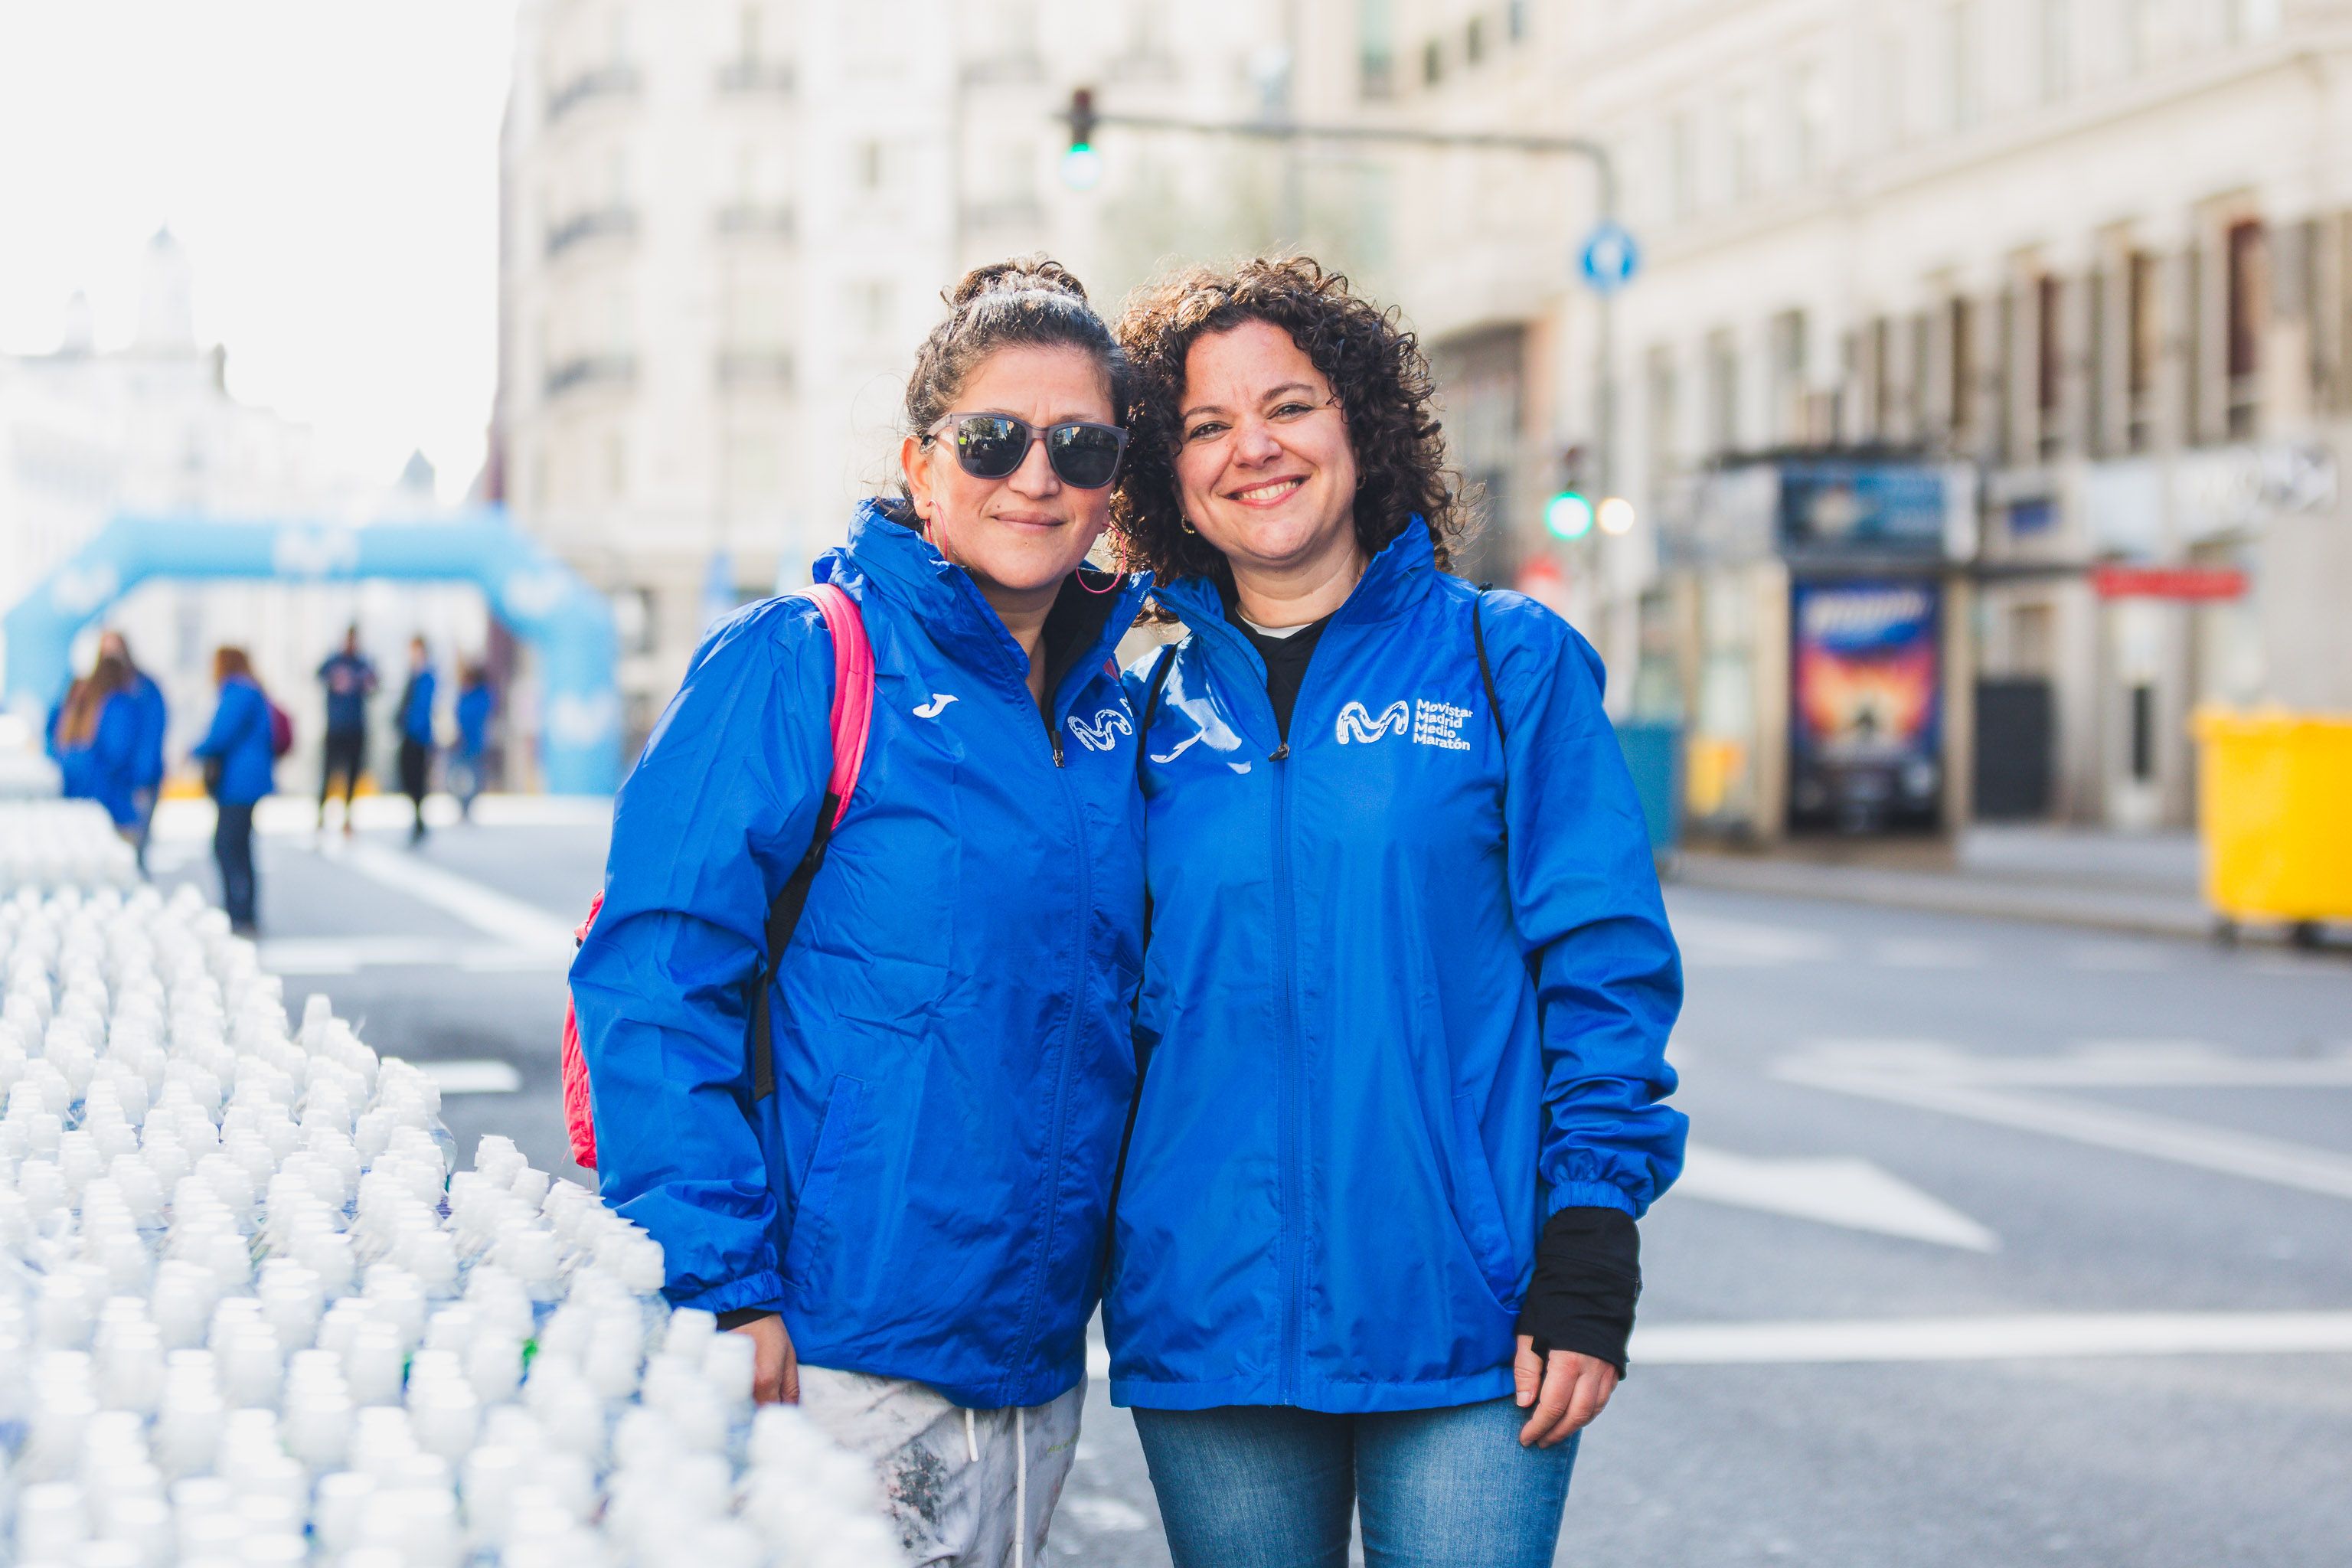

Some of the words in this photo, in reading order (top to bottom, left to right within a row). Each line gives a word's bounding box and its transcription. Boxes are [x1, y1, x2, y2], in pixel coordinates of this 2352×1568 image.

[1416, 698, 1473, 718] Movistar
[1415, 710, 1463, 728] Madrid
[1414, 721, 1456, 739] Medio
[1413, 732, 1471, 750] Maratón
